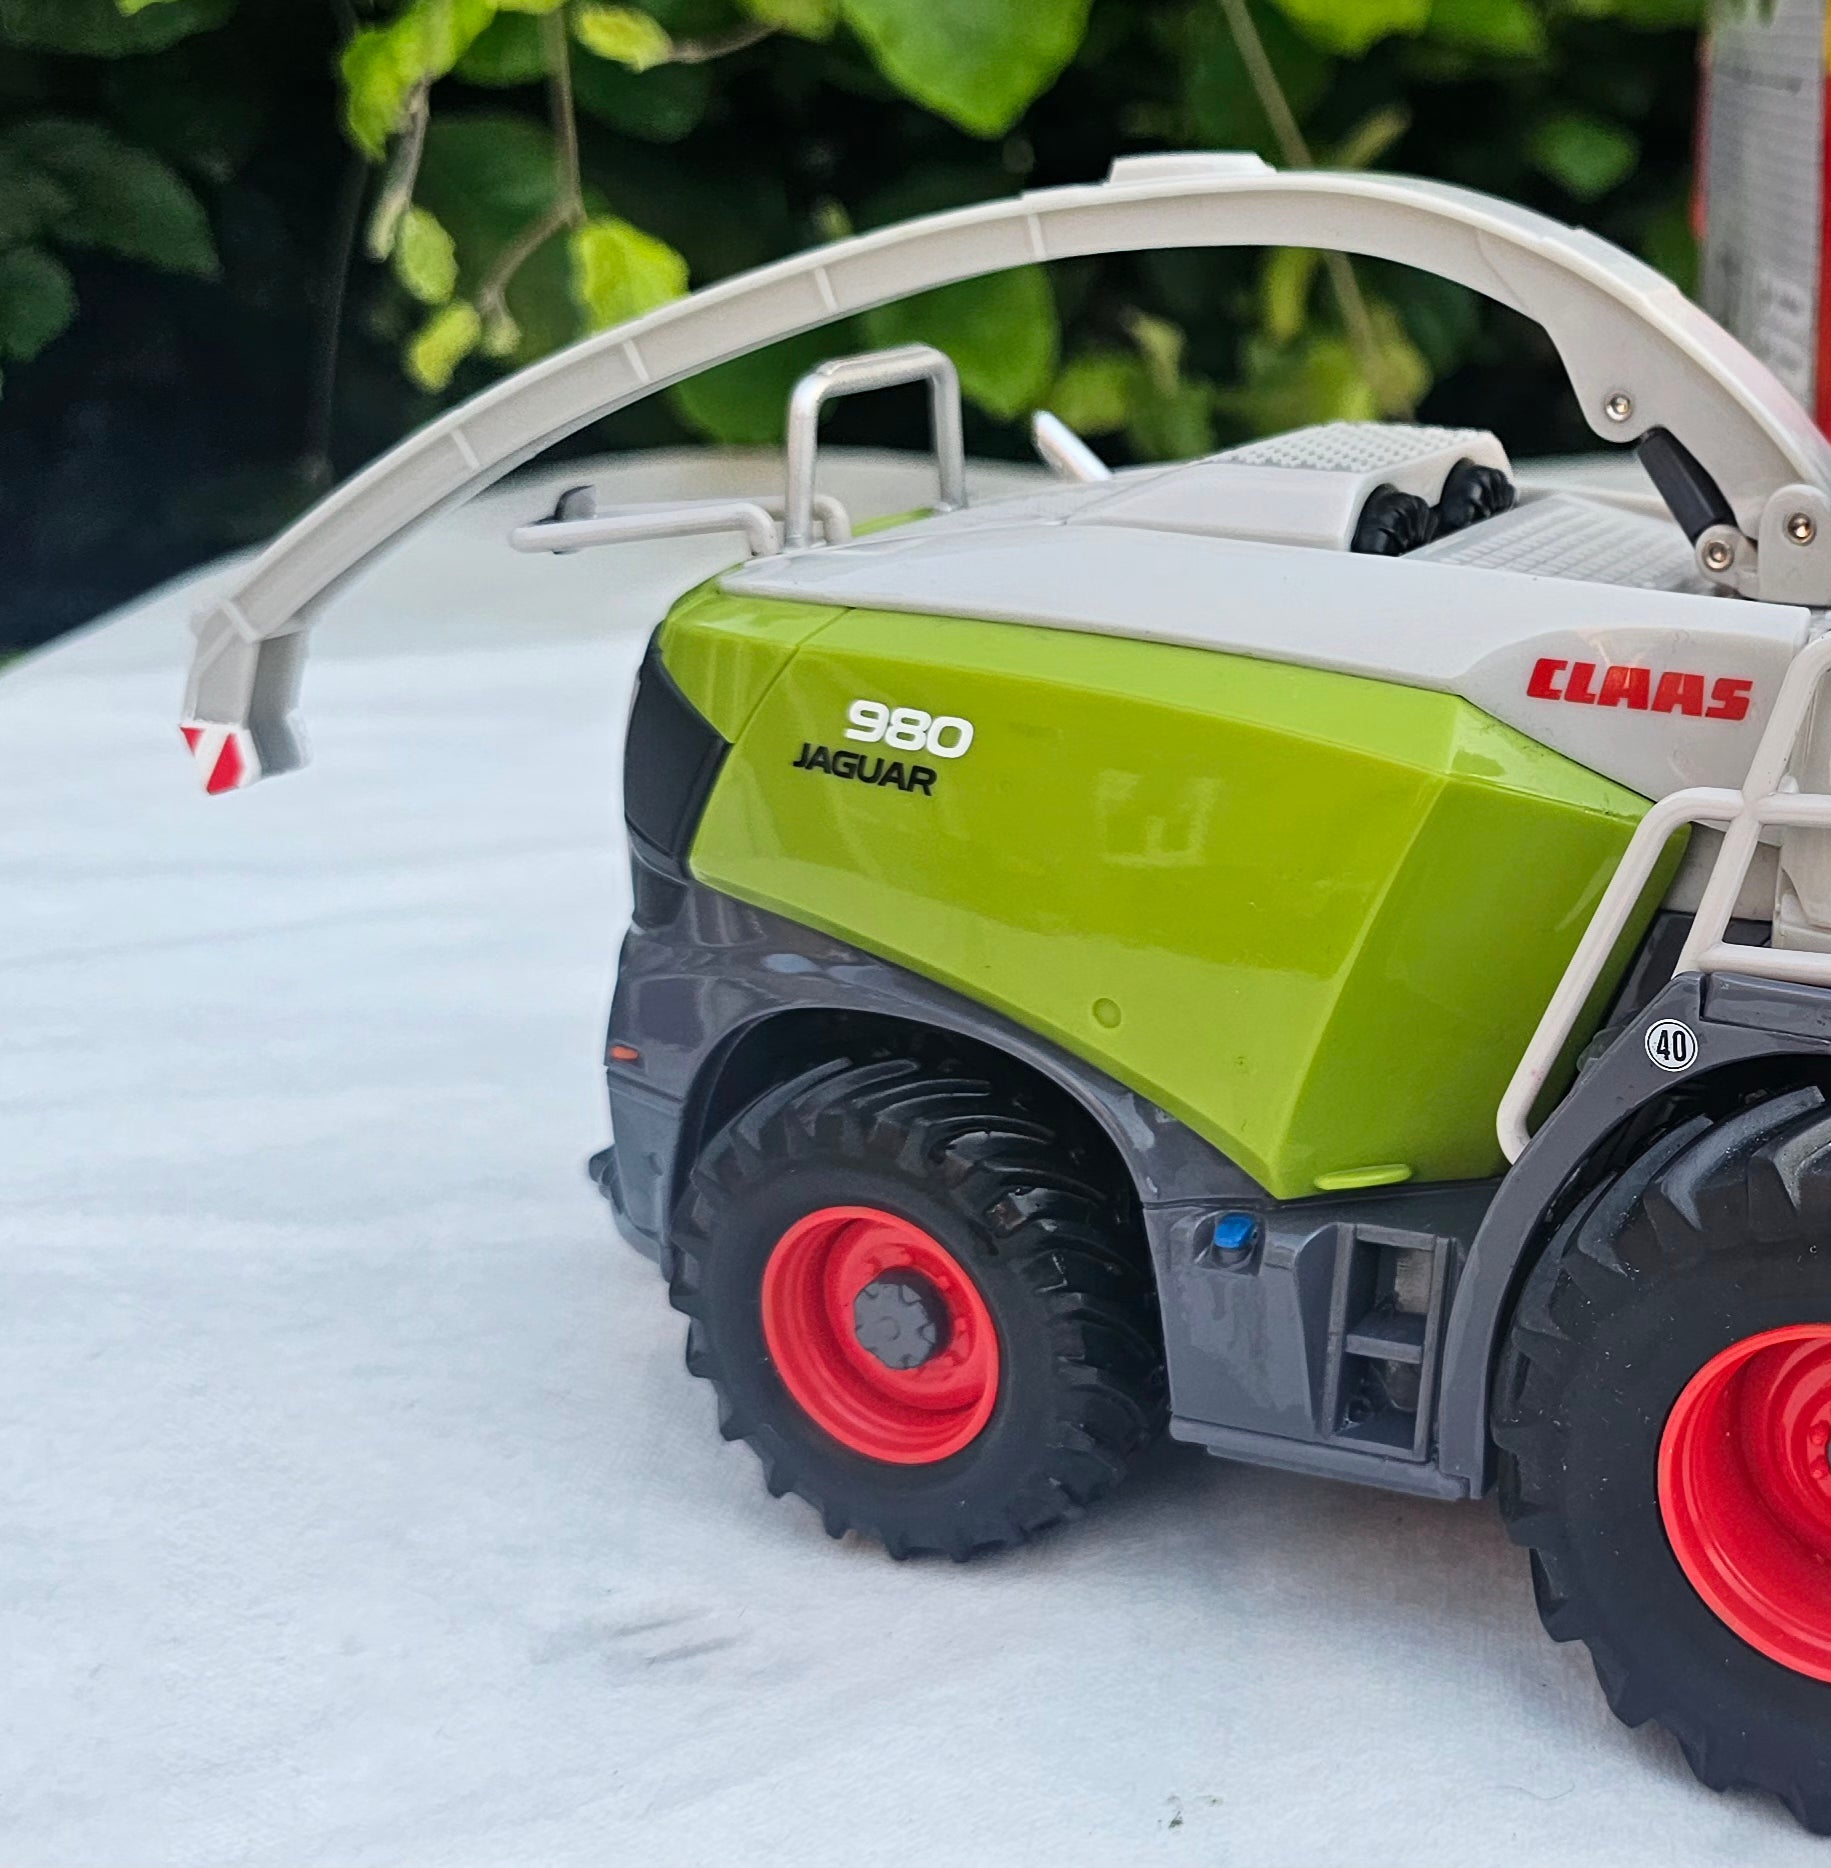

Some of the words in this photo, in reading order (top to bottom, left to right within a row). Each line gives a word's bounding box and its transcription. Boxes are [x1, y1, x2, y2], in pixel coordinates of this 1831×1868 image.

[1526, 658, 1753, 721] CLAAS
[845, 699, 974, 759] 980
[792, 742, 938, 796] JAGUAR
[1656, 1029, 1687, 1062] 40
